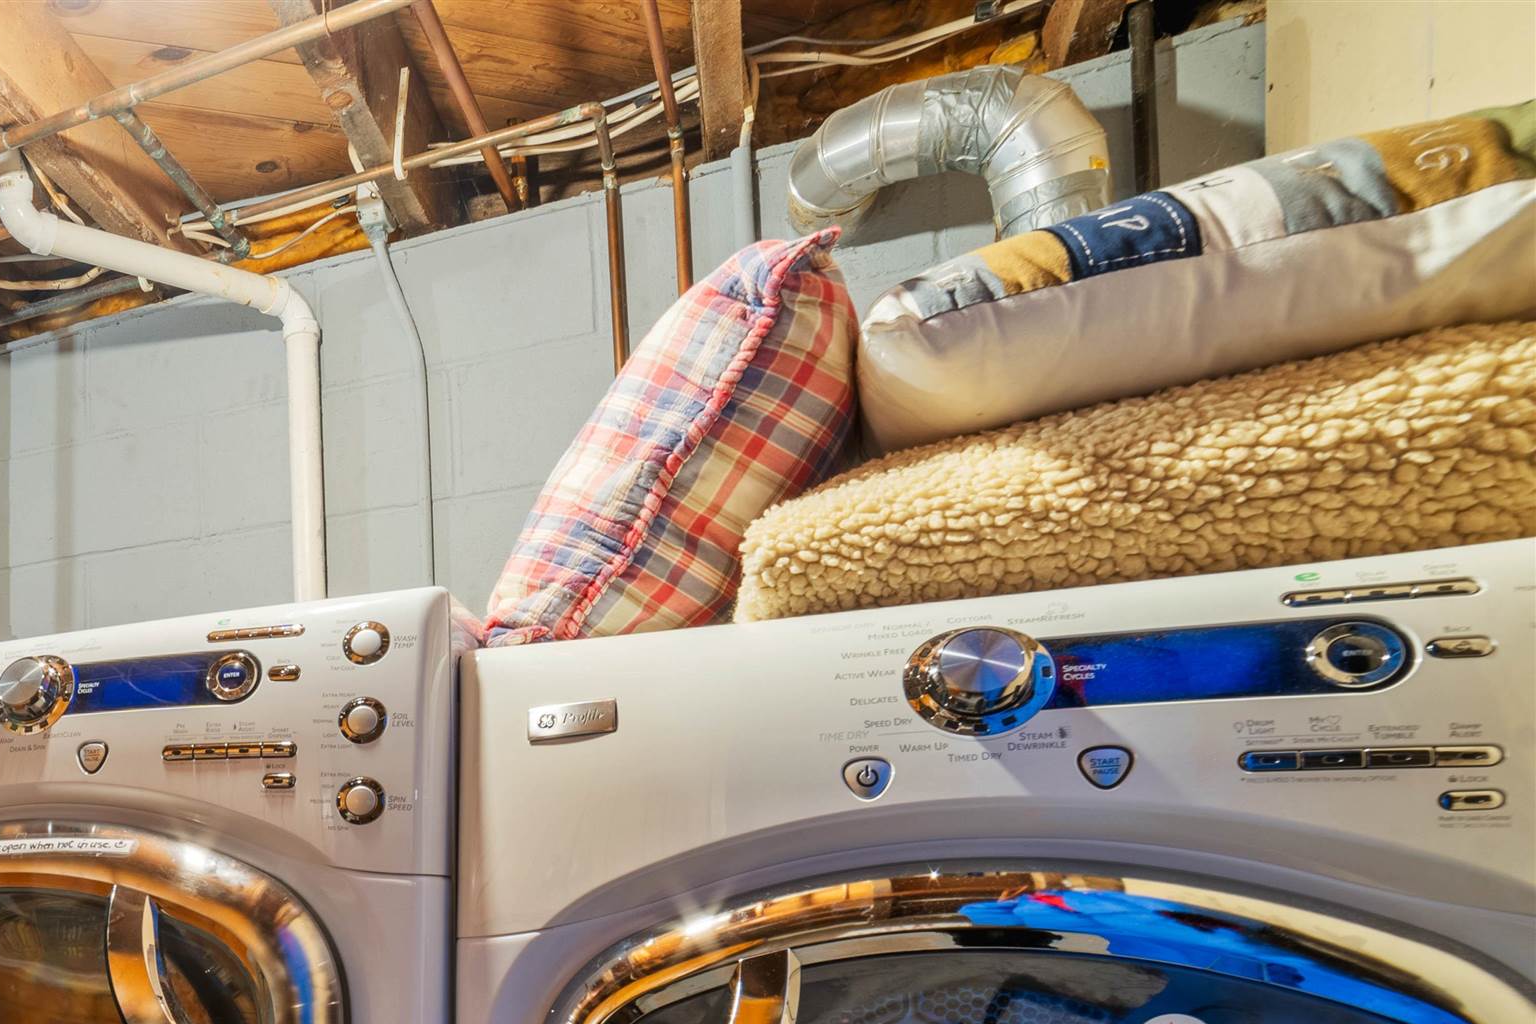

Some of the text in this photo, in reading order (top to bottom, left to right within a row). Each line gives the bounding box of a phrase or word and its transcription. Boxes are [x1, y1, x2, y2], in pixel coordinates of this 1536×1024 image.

[946, 614, 992, 625] COTTONS
[393, 634, 417, 642] WASH
[1062, 663, 1107, 673] SPECIALTY
[223, 671, 240, 679] ENTER
[834, 669, 897, 681] ACTIVE WEAR
[1062, 672, 1096, 681] CYCLES
[850, 696, 899, 706] DELICATES
[392, 712, 408, 720] SOIL
[562, 707, 606, 727] Profile
[392, 720, 415, 728] LEVEL
[864, 717, 913, 729] SPEED DRY
[818, 730, 870, 742] TIME DRY
[1019, 731, 1054, 742] STEAM
[849, 744, 880, 754] POWER
[899, 742, 950, 753] WARM UP
[1007, 740, 1068, 752] DEWRINKLE
[947, 752, 1003, 763] TIMED DRY
[1089, 757, 1121, 767] START
[388, 795, 407, 803] SPIN
[387, 803, 413, 811] SPEED
[29, 840, 54, 850] when
[57, 840, 75, 849] not
